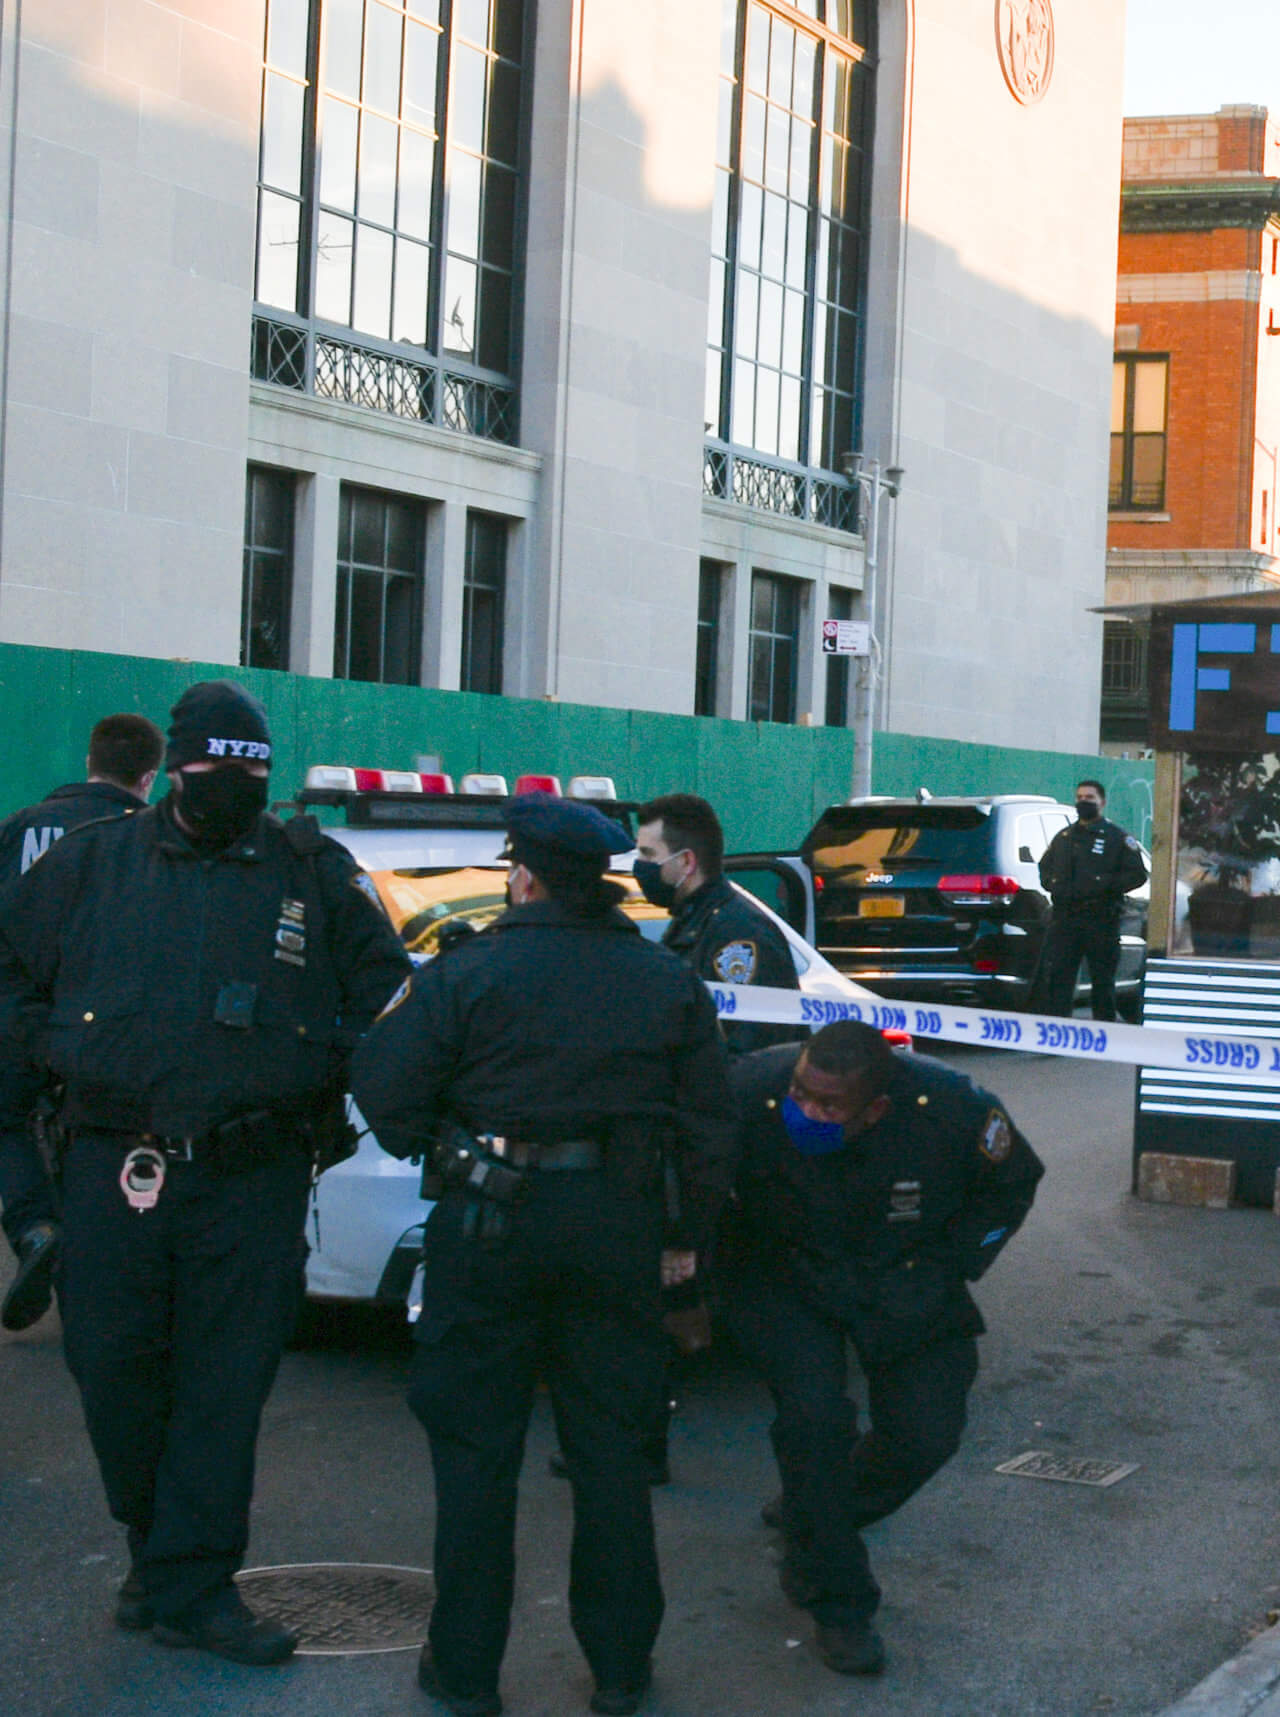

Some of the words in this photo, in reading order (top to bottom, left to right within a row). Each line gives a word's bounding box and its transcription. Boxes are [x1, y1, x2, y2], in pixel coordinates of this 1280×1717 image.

[207, 738, 271, 760] NYPD
[865, 872, 894, 884] Jeep
[800, 997, 862, 1021] CROSS
[871, 1005, 907, 1030] NOT
[915, 1009, 943, 1034] DO
[979, 1016, 1022, 1043] LINE
[1035, 1021, 1108, 1053] POLICE
[1184, 1036, 1261, 1070] CROSS
